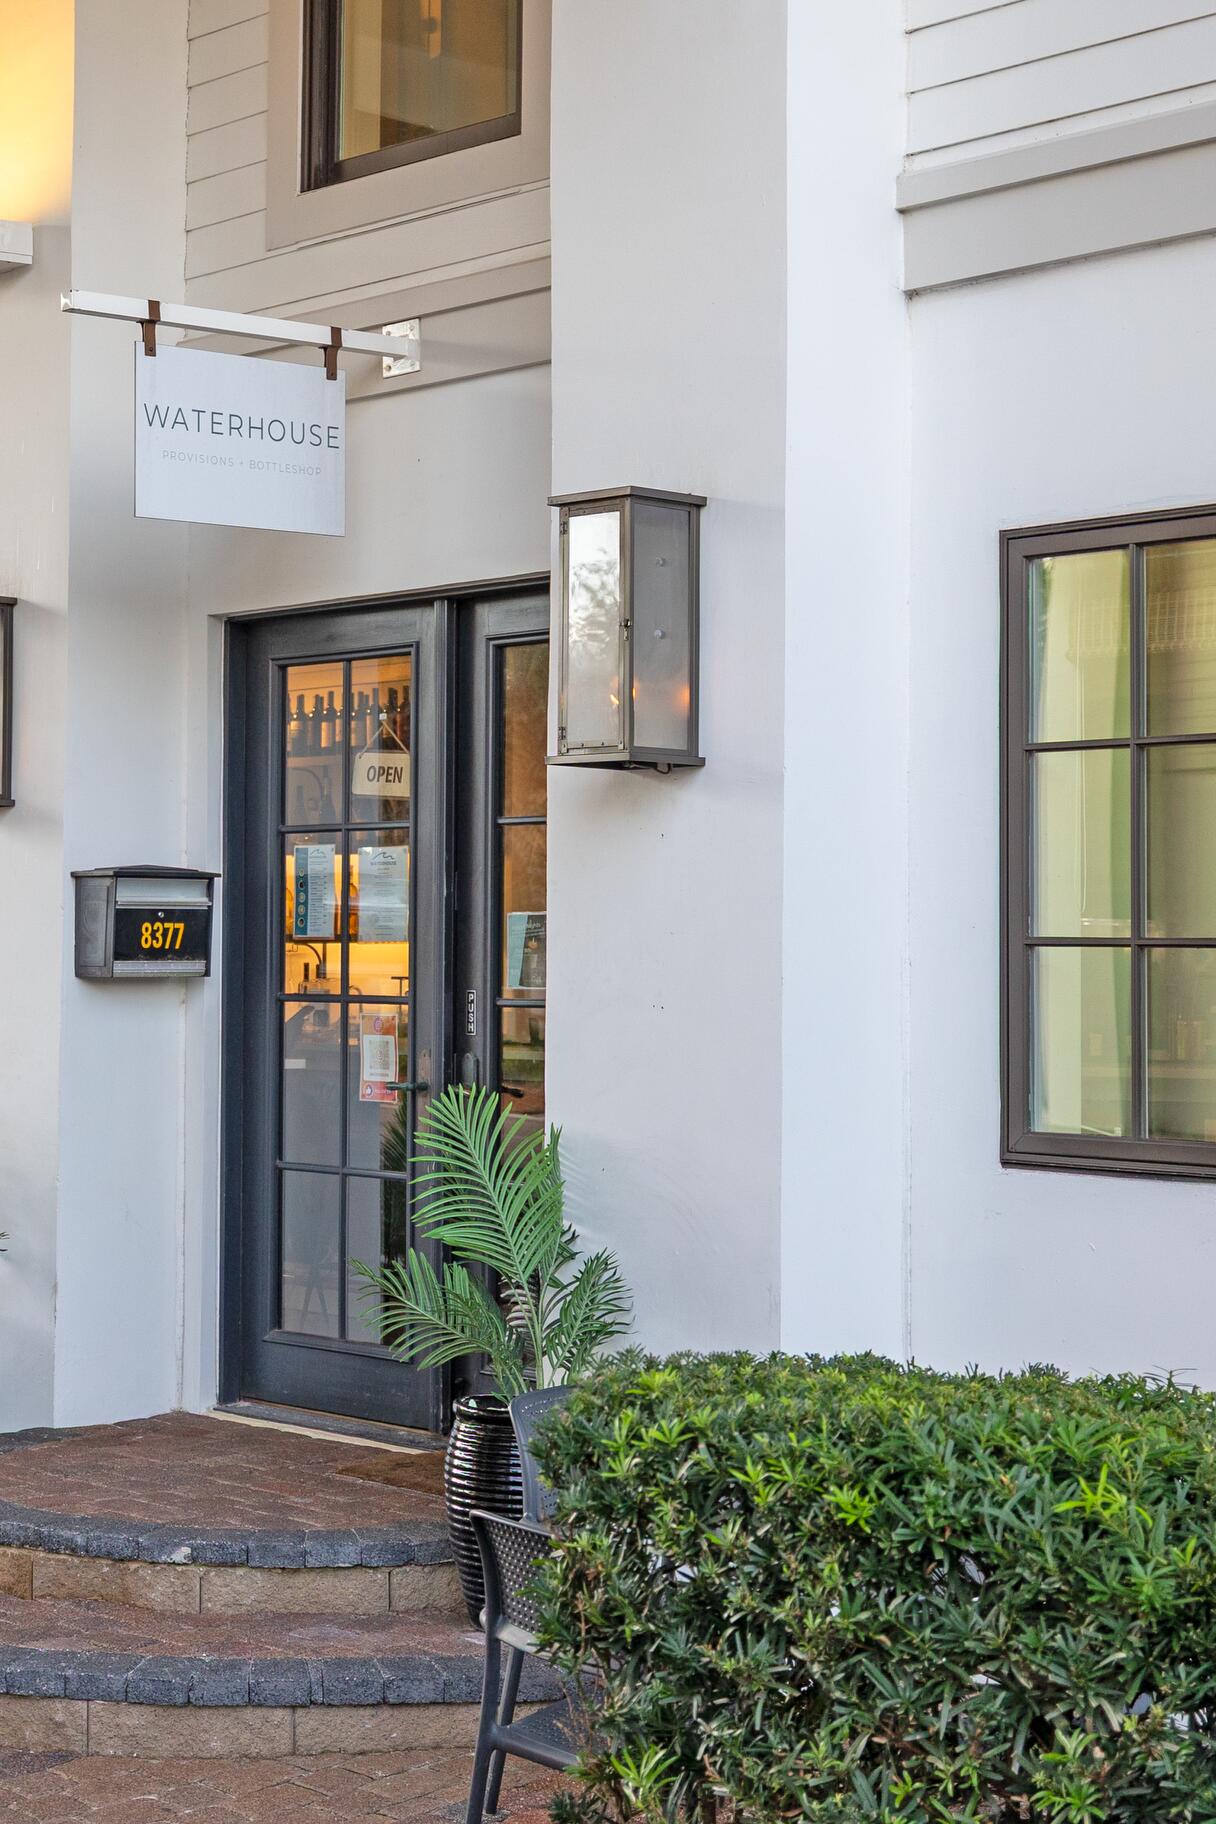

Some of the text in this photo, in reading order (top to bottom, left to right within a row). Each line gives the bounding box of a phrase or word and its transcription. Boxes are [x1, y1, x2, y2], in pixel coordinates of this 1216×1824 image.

[144, 403, 340, 449] WATERHOUSE
[162, 449, 235, 468] PROVISIONS
[248, 459, 322, 476] BOTTLESHOP
[366, 765, 404, 784] OPEN
[140, 921, 185, 950] 8377
[467, 993, 475, 1033] PUSH
